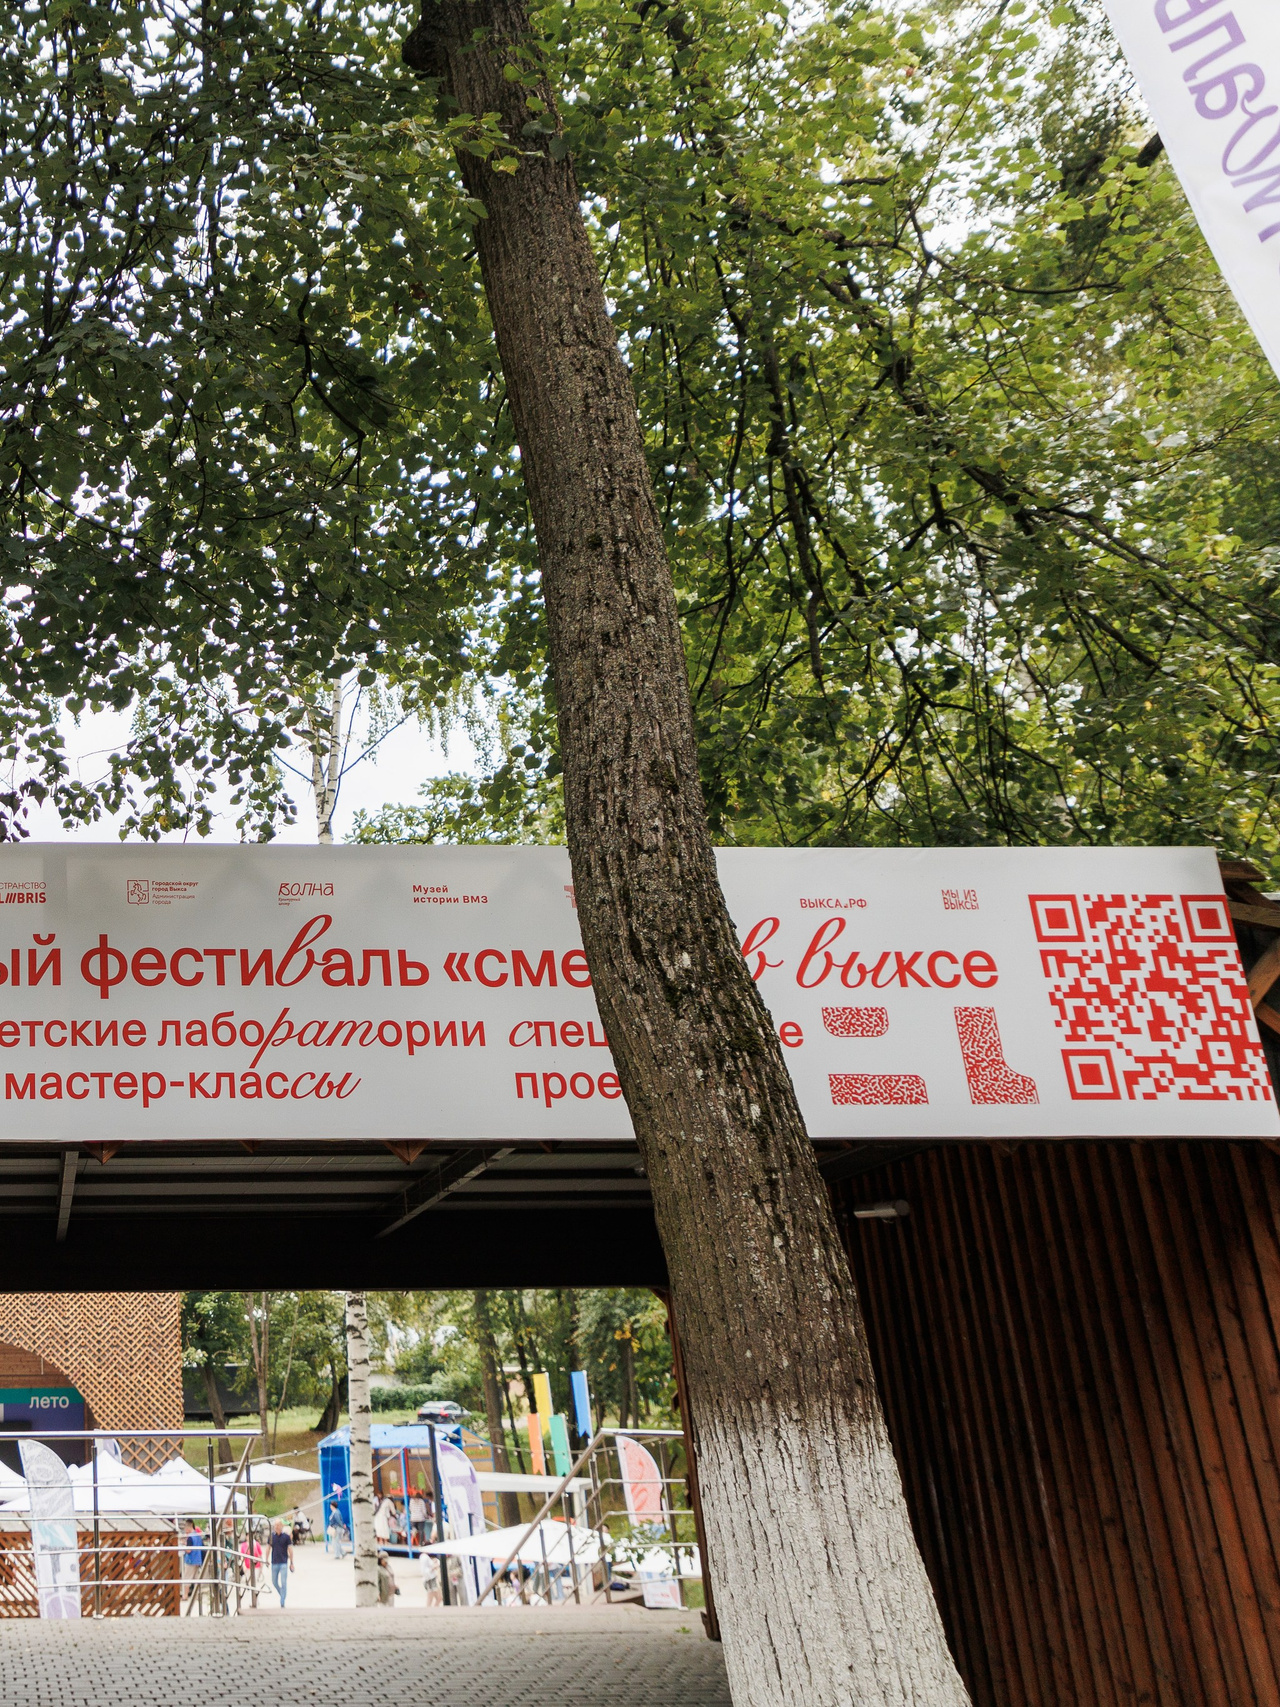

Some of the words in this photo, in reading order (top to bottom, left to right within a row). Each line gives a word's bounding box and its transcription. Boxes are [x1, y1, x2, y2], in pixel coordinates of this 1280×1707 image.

[412, 883, 449, 894] Музей
[941, 889, 960, 899] МЫ
[963, 889, 978, 902] ИЗ
[413, 895, 460, 906] истории
[462, 895, 489, 905] ВМЗ
[800, 898, 868, 909] ВЫКСА.РФ
[942, 897, 980, 911] ВЫКСЫ
[80, 914, 430, 1000] фестиваль
[442, 948, 593, 989] «сме
[795, 916, 1000, 989] выксе
[157, 1007, 487, 1070] лаборатории
[4, 1070, 362, 1109] мастер-классы
[514, 1071, 623, 1109] прое
[29, 1395, 70, 1409] лето
